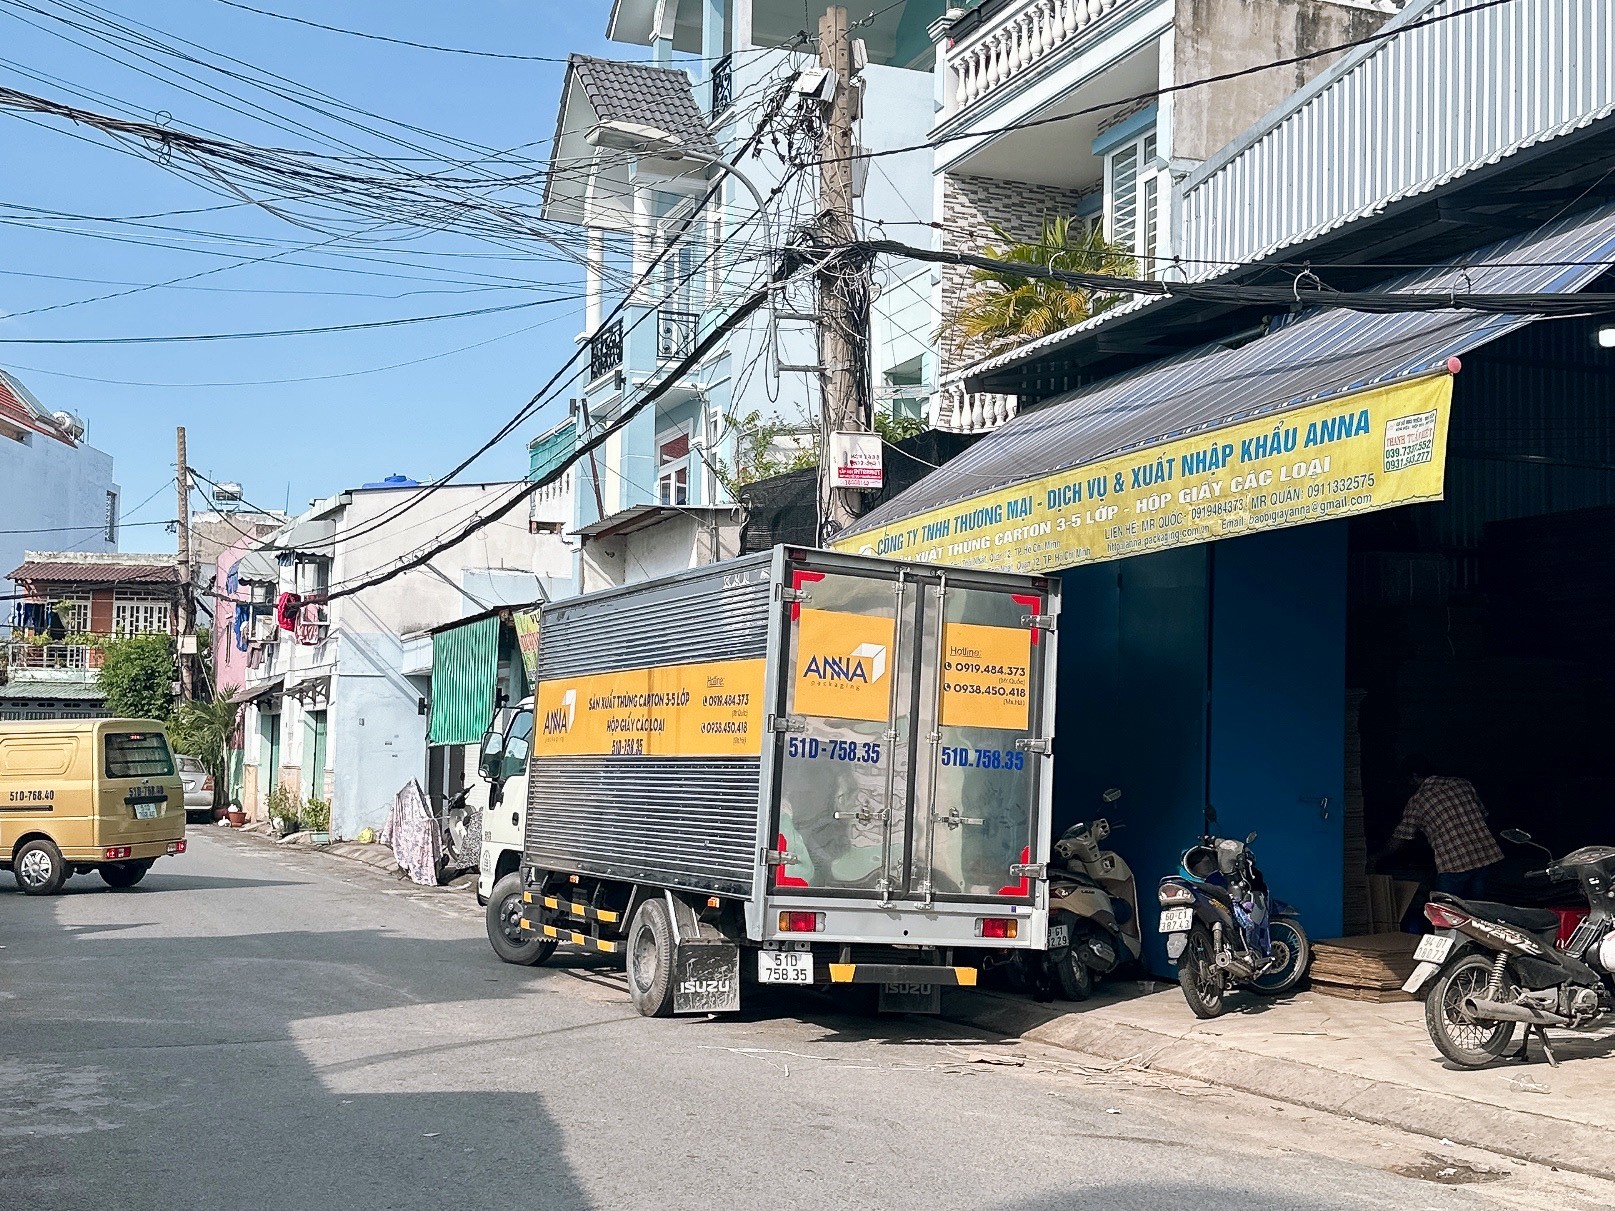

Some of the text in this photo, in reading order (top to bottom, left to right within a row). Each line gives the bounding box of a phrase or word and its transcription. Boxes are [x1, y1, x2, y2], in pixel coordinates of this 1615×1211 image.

[878, 533, 904, 556] CÔNG
[906, 528, 919, 548] TY
[921, 518, 951, 544] TNHH
[953, 503, 1003, 534] THƯƠNG
[1006, 495, 1033, 521] MẠI
[1047, 481, 1082, 513] DỊCH
[1086, 475, 1107, 502] VỤ
[1113, 471, 1125, 494] &
[1131, 451, 1176, 490] XUẤT
[1181, 441, 1234, 478] NHẬP
[1240, 420, 1298, 464] KHẨU
[1303, 408, 1370, 449] ANNA
[947, 535, 991, 558] THÙNG
[994, 520, 1052, 546] CARTON
[1056, 513, 1082, 532] 3-5
[1086, 504, 1119, 525] LỚP
[1135, 491, 1172, 514] HỘP
[1178, 477, 1223, 504] GIẤY
[1229, 468, 1273, 494] CÁC
[1279, 455, 1332, 483] LOẠI
[1191, 498, 1243, 520] 0919484373
[1251, 494, 1267, 510] MR
[1307, 472, 1375, 499] 0911332575
[803, 654, 868, 683] ANNA
[955, 662, 1026, 677] 0919.484.373
[638, 692, 664, 708] CARTON
[665, 691, 676, 707] 3-5
[953, 683, 1026, 698] 0938.450.418
[543, 707, 568, 735] ANNA
[941, 746, 1025, 771] 51D.758.35
[774, 953, 798, 967] 51D
[765, 967, 807, 981] 758.35
[679, 979, 731, 995] ISUZU
